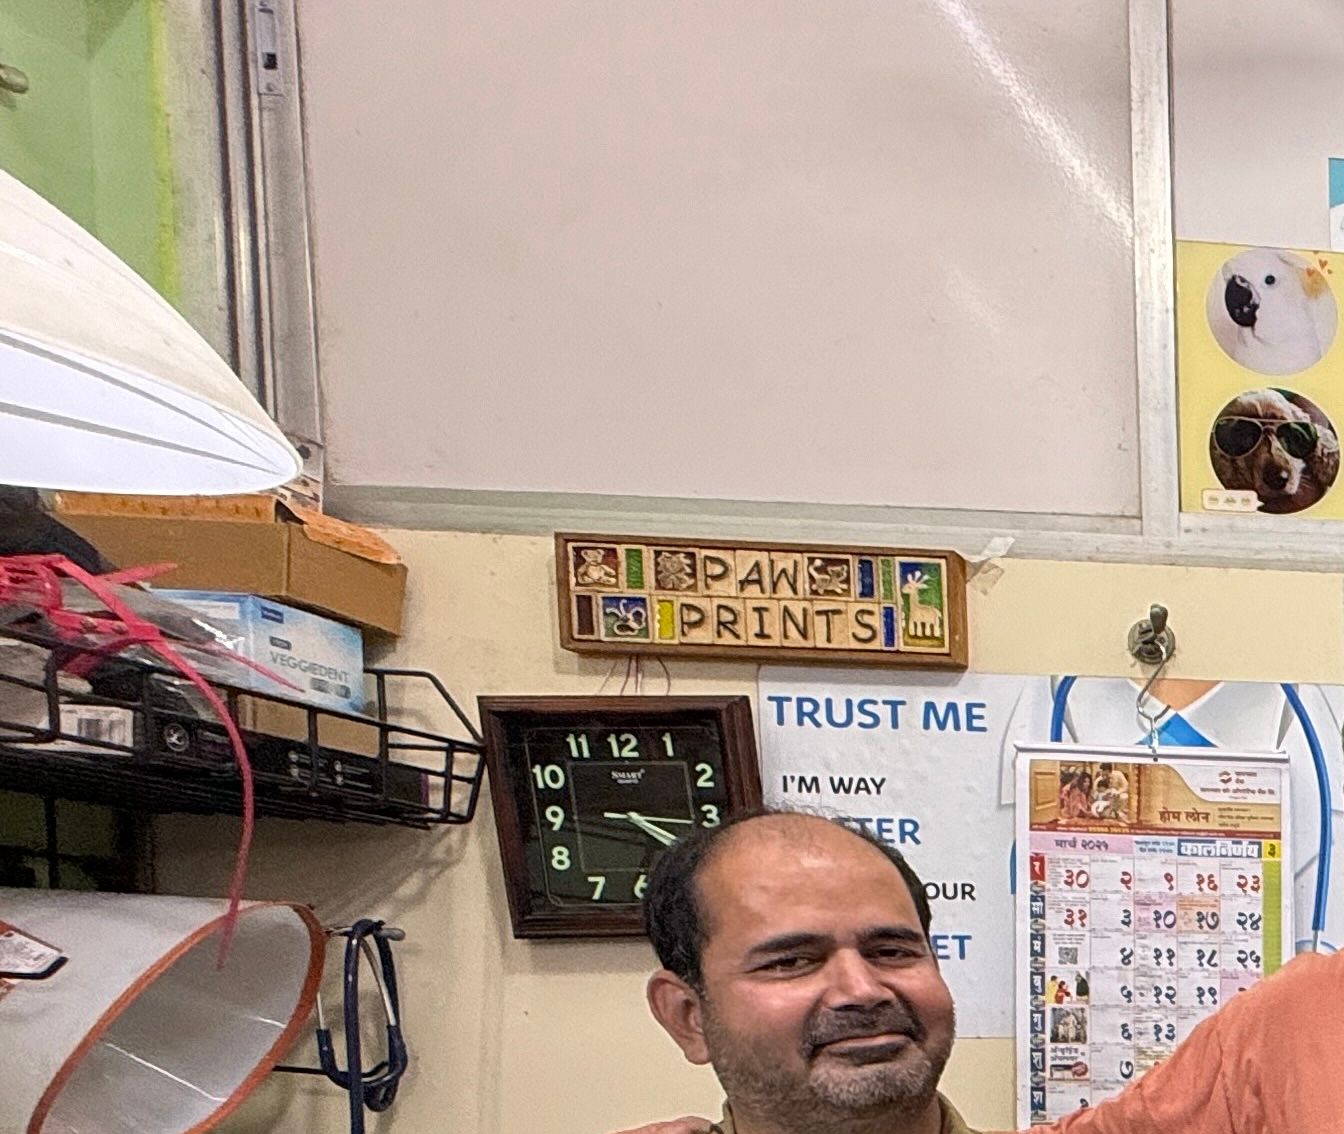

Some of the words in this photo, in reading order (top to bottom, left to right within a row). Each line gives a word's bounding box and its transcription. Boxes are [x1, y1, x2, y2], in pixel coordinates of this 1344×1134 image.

[703, 555, 798, 595] PAW
[680, 605, 878, 643] PRINTS
[270, 651, 349, 682] VEGGIEDENT
[767, 695, 907, 730] TRUST
[922, 701, 988, 733] ME
[566, 733, 590, 758] 11
[607, 733, 640, 758] 12
[662, 732, 675, 757] 1
[532, 764, 565, 789] 10
[695, 763, 715, 788] 2
[782, 775, 821, 794] I'M
[829, 777, 887, 795] WAY
[545, 805, 565, 831] 9
[700, 804, 720, 828] 3
[551, 846, 571, 870] 8
[1180, 843, 1260, 859] कालनिर्णय
[1267, 844, 1276, 858] ३
[587, 876, 605, 900] 7
[634, 874, 648, 899] 6
[1064, 869, 1089, 888] ३०
[1120, 871, 1132, 890] २
[1196, 873, 1218, 891] १६
[1236, 874, 1261, 893] २३
[922, 882, 976, 901] OUR
[1063, 909, 1088, 928] ३१
[1121, 909, 1132, 927] ३
[1153, 910, 1176, 929] १०
[1196, 910, 1219, 931] १७
[1236, 911, 1262, 931] २४
[931, 935, 972, 960] ET
[1120, 947, 1133, 966] ४
[1153, 947, 1176, 967] ११
[1196, 949, 1218, 967] १८
[1153, 985, 1177, 1005] १२
[1120, 1023, 1133, 1042] ६
[1153, 1023, 1176, 1042] १३
[1120, 1060, 1133, 1080] ७
